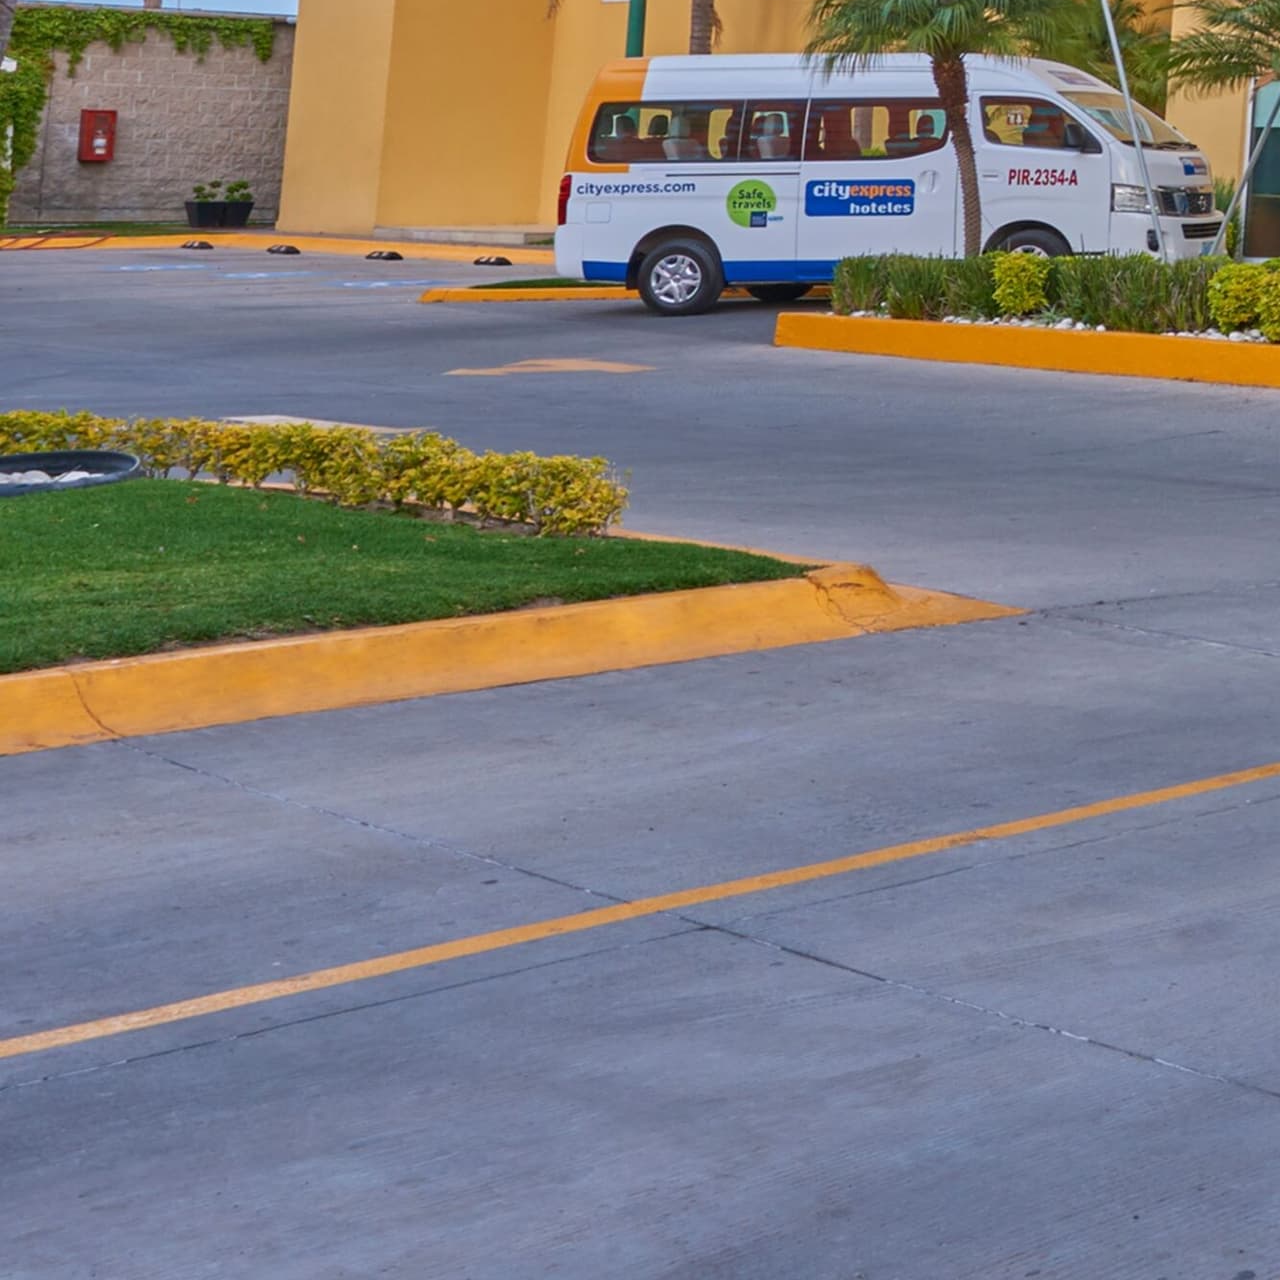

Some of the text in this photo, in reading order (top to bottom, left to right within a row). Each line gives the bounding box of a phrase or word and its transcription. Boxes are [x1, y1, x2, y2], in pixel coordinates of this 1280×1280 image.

[1007, 169, 1078, 186] PIR-2354-A
[576, 182, 696, 197] cityexpress.com
[738, 188, 764, 200] Safe
[812, 182, 912, 200] cityexpress
[732, 198, 772, 209] travels
[849, 201, 912, 214] hoteles
